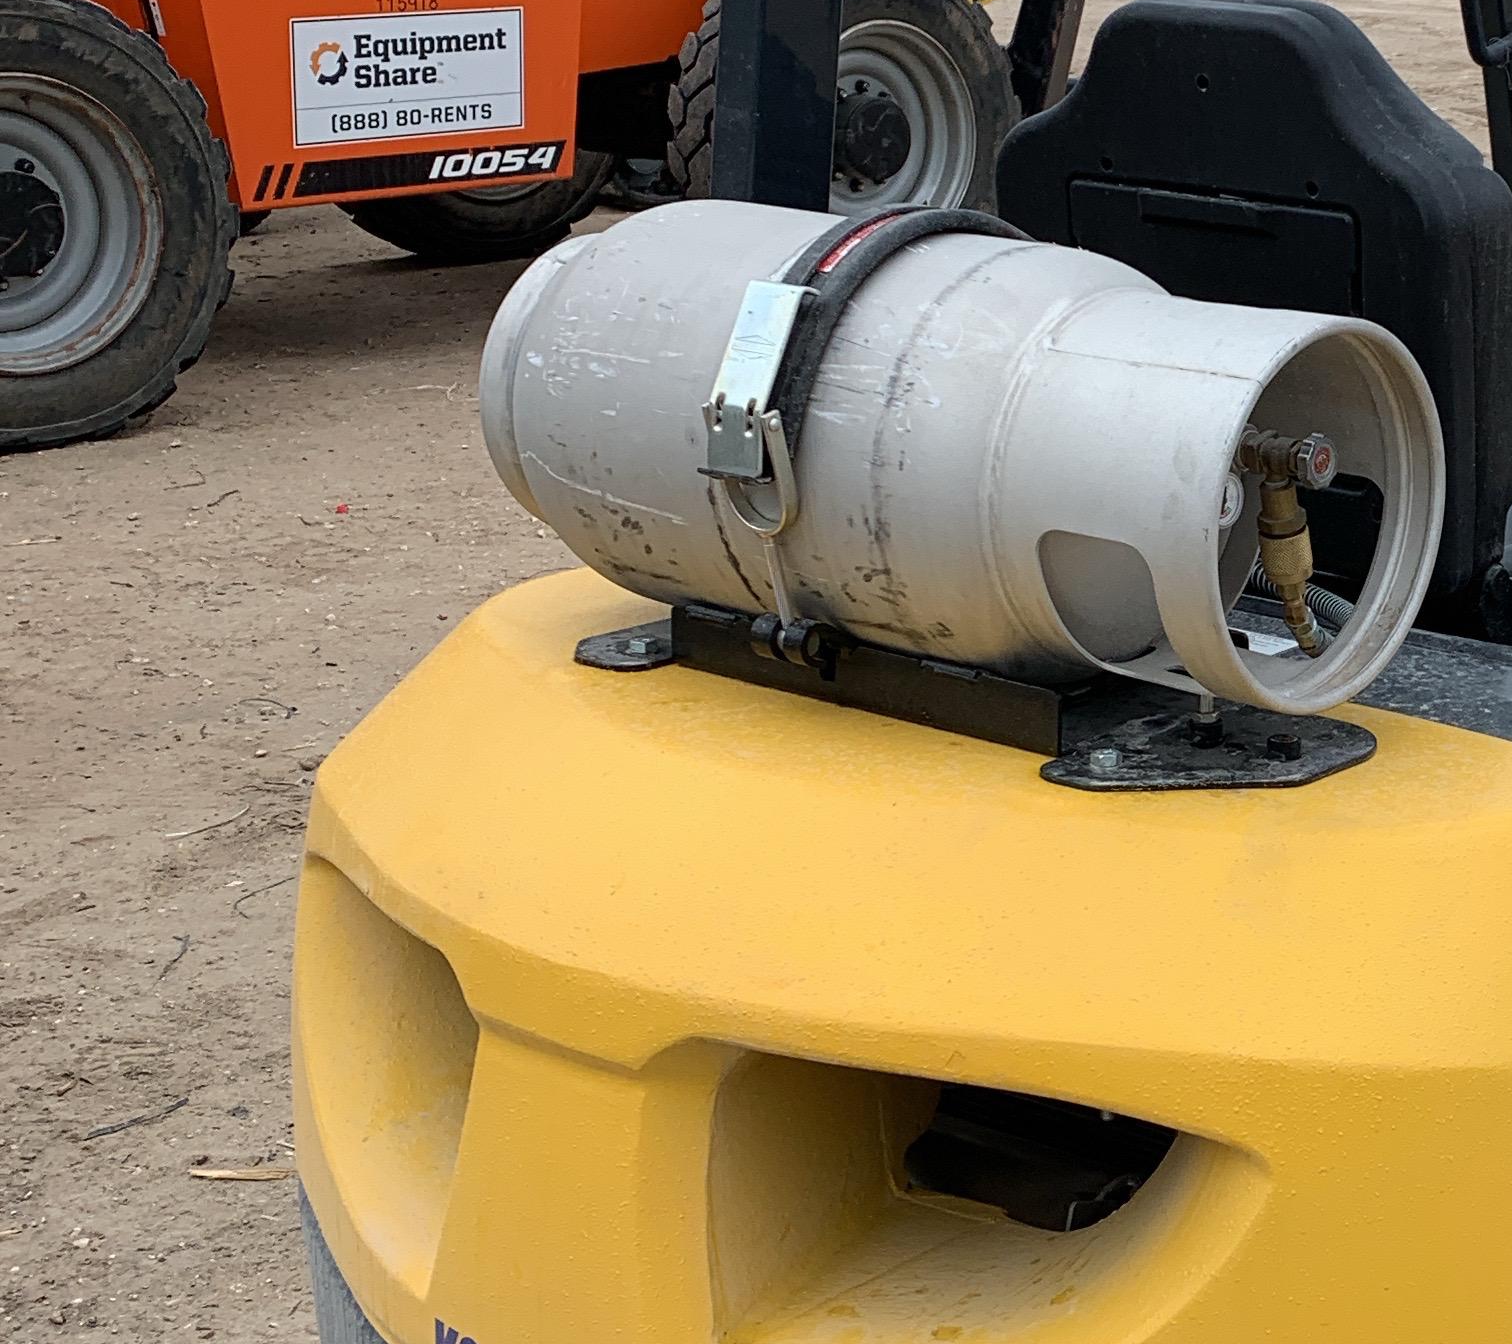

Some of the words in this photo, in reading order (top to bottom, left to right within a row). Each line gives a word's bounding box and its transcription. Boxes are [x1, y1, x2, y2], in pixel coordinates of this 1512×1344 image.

[354, 28, 507, 63] Equipment
[354, 64, 438, 89] Share
[331, 111, 388, 134] (888)
[396, 103, 492, 128] 80-RENTS
[429, 146, 556, 179] 10054
